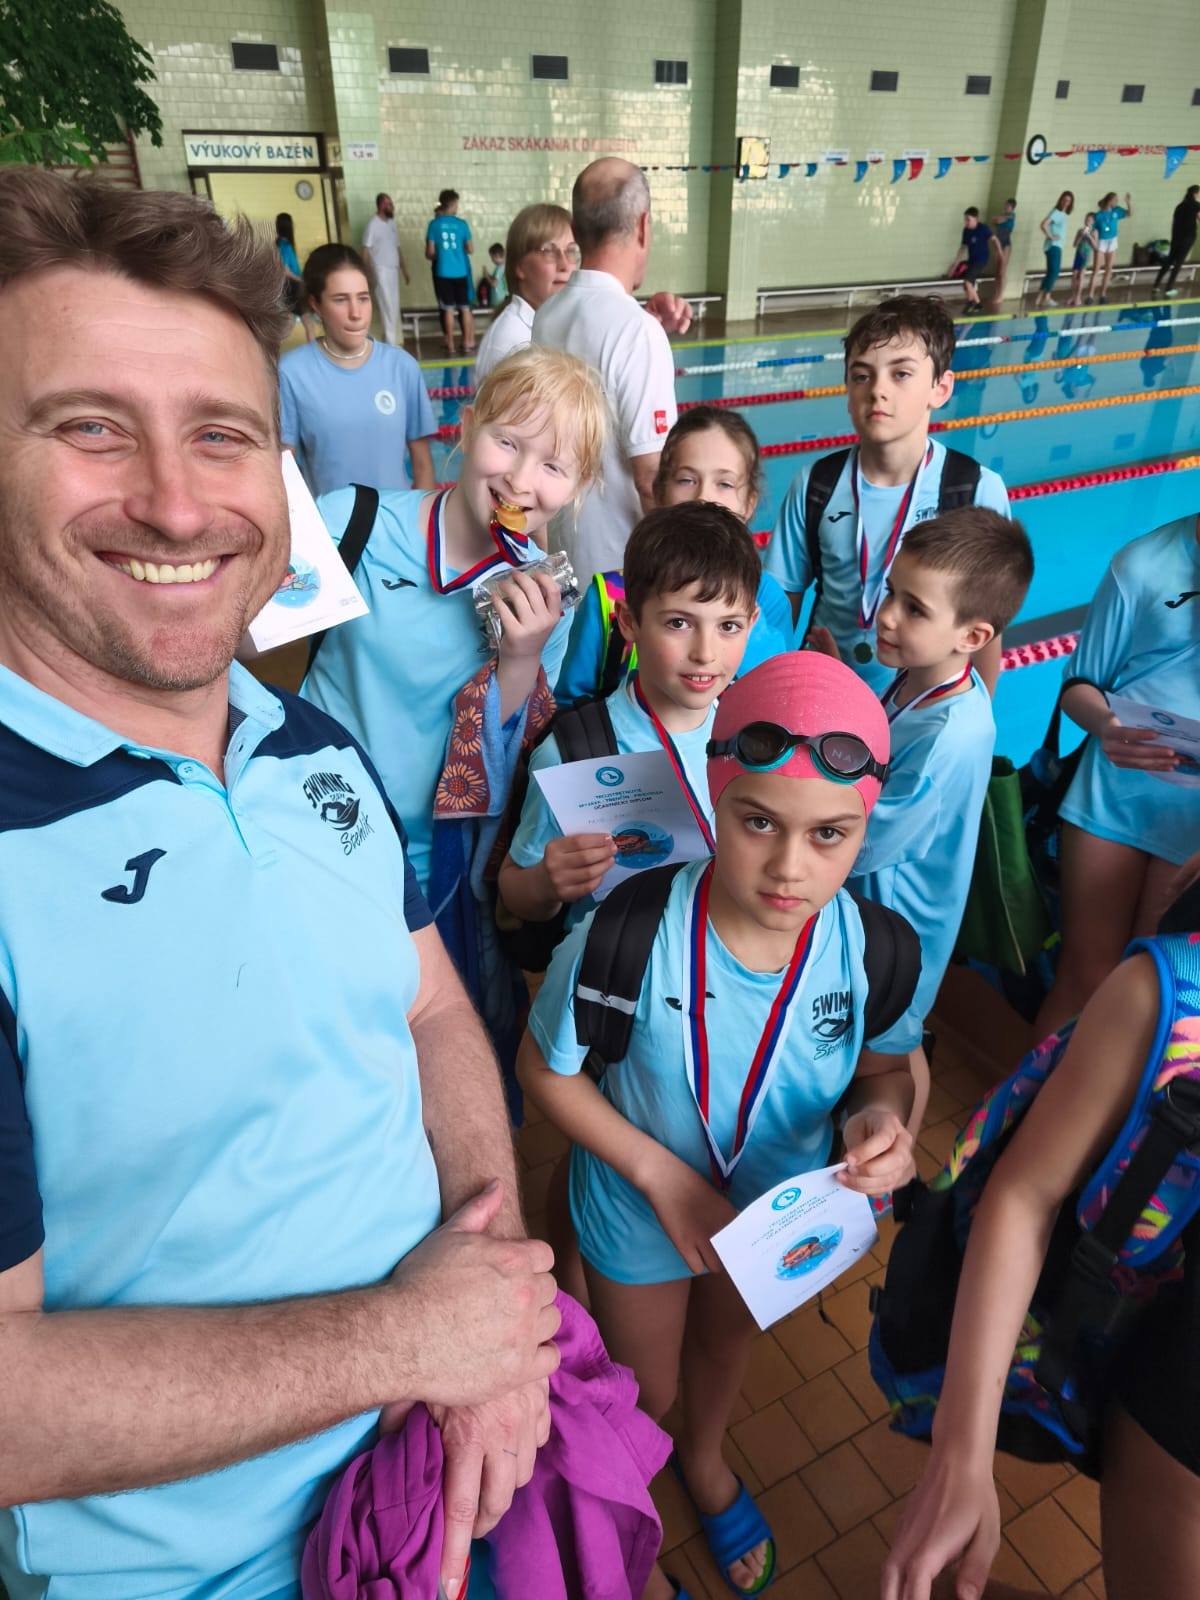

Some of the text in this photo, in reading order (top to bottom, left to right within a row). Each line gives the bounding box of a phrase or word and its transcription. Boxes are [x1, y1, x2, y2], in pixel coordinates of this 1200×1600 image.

[190, 140, 314, 159] VÝUKOVÝ BAZÉN
[463, 134, 505, 150] ZÁKAZ
